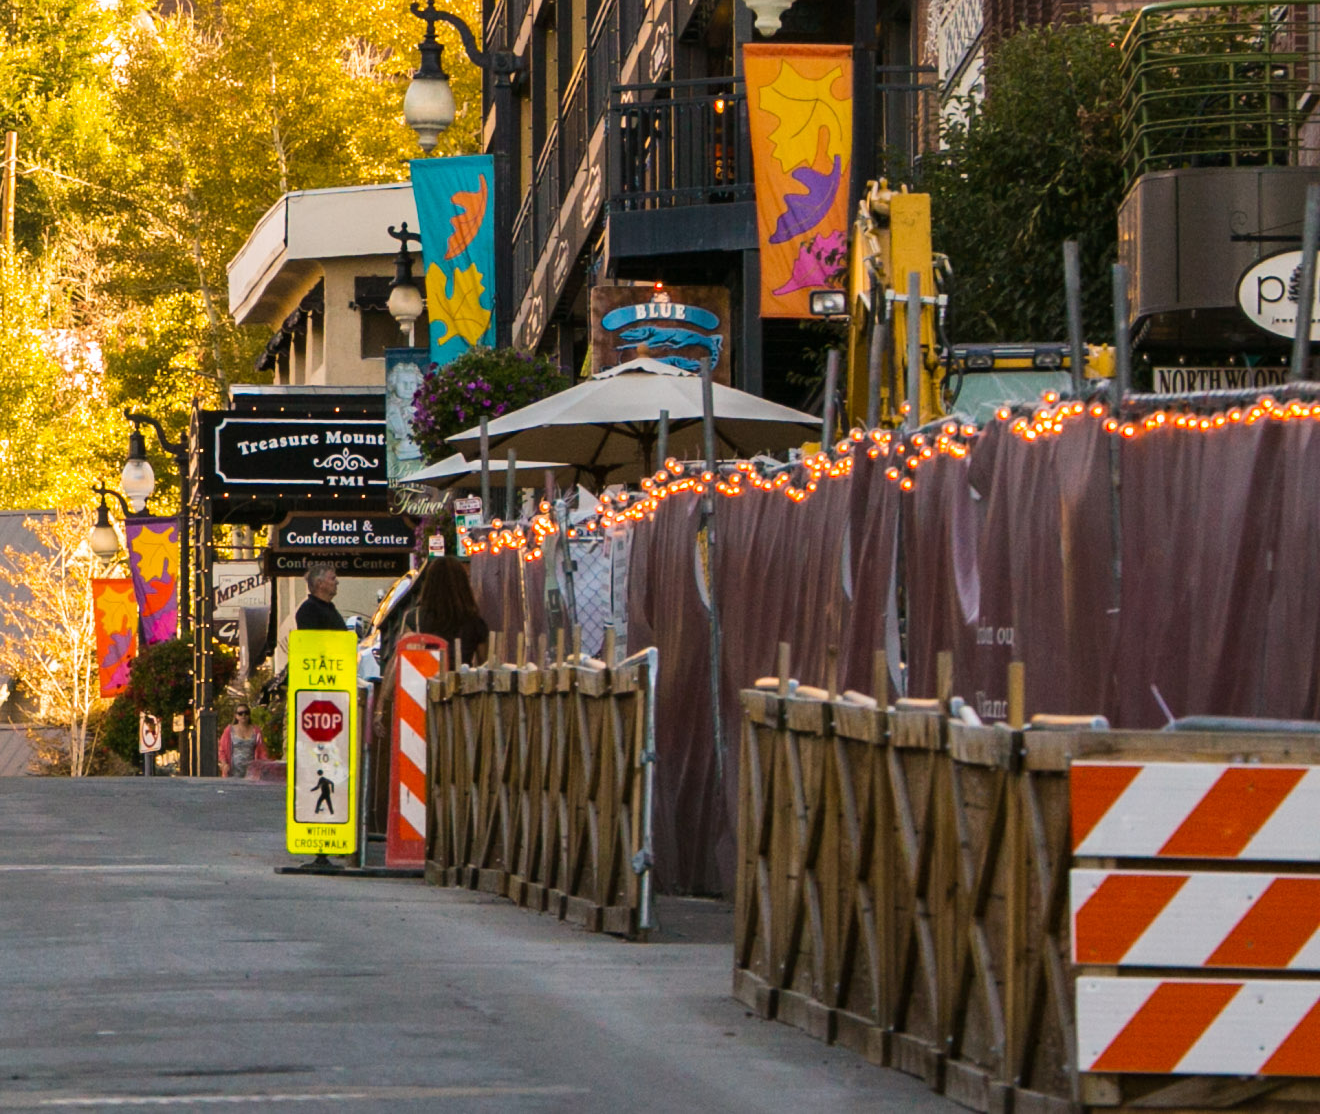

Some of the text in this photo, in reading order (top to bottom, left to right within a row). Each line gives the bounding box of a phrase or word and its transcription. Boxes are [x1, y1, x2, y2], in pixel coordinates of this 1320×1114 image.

[635, 303, 686, 320] BLUE
[237, 431, 386, 456] Treasure Mount
[326, 476, 365, 487] TMI
[321, 519, 374, 533] Hotel &
[286, 532, 409, 546] Conference Center
[353, 557, 397, 570] Center
[302, 658, 344, 671] STATE
[308, 674, 337, 686] LAW
[303, 713, 343, 730] STOP
[306, 827, 337, 837] WITHIN
[294, 838, 349, 849] CROSSWALK
